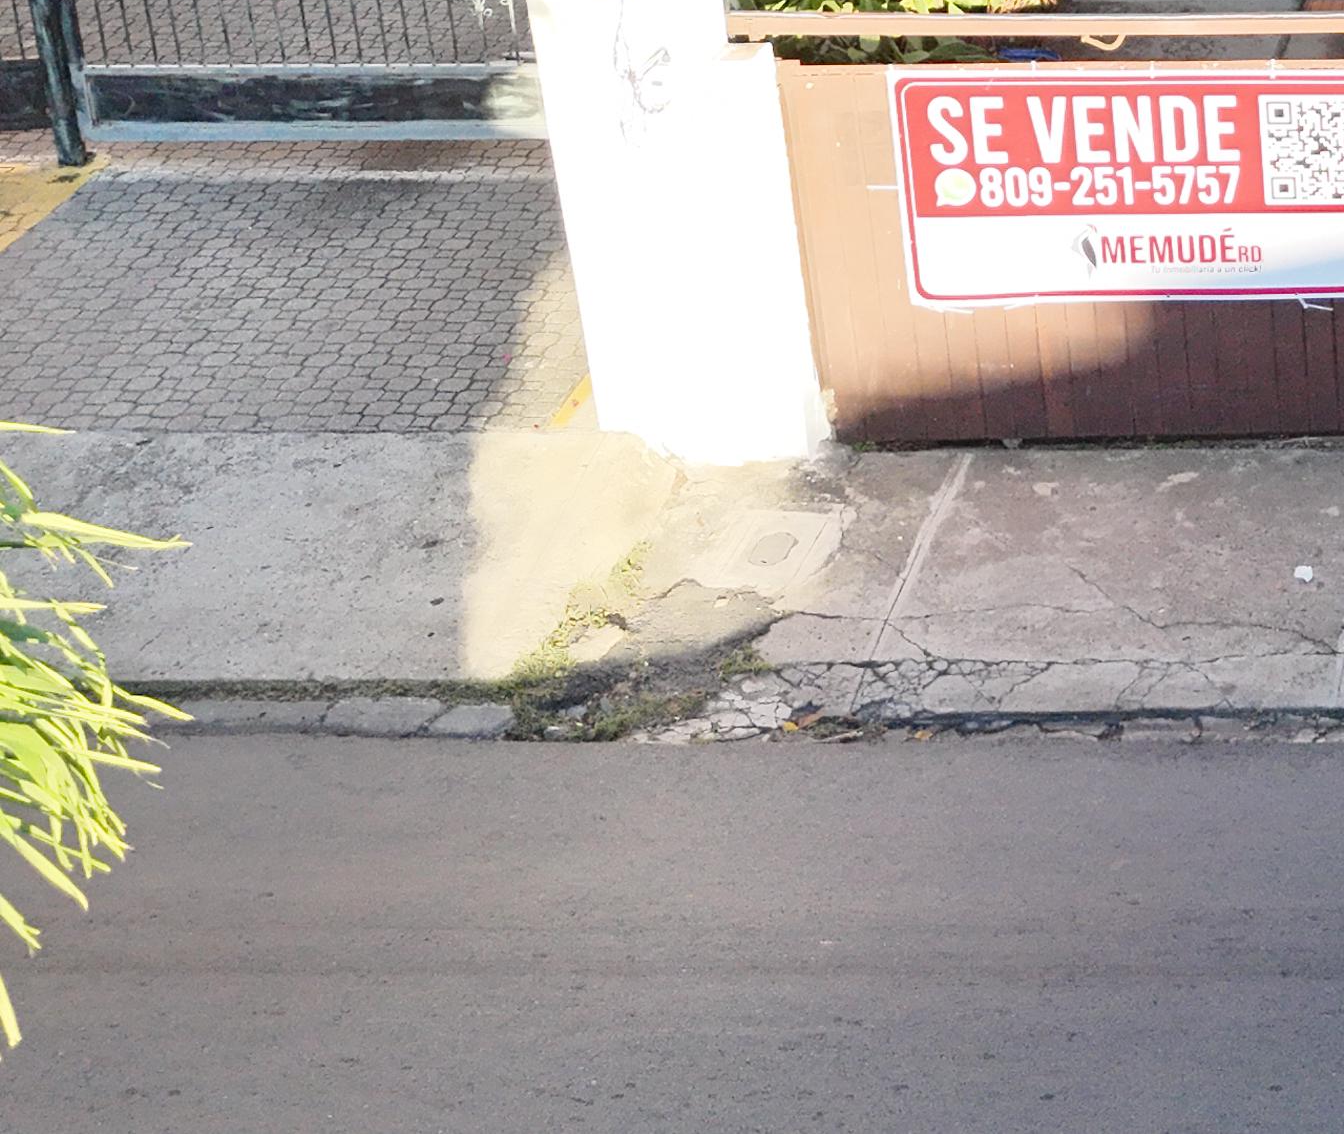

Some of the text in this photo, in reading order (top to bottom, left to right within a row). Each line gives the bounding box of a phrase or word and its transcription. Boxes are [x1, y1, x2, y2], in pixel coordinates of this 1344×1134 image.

[927, 95, 1241, 165] SE VENDE
[979, 165, 1241, 207] 809-251-5757
